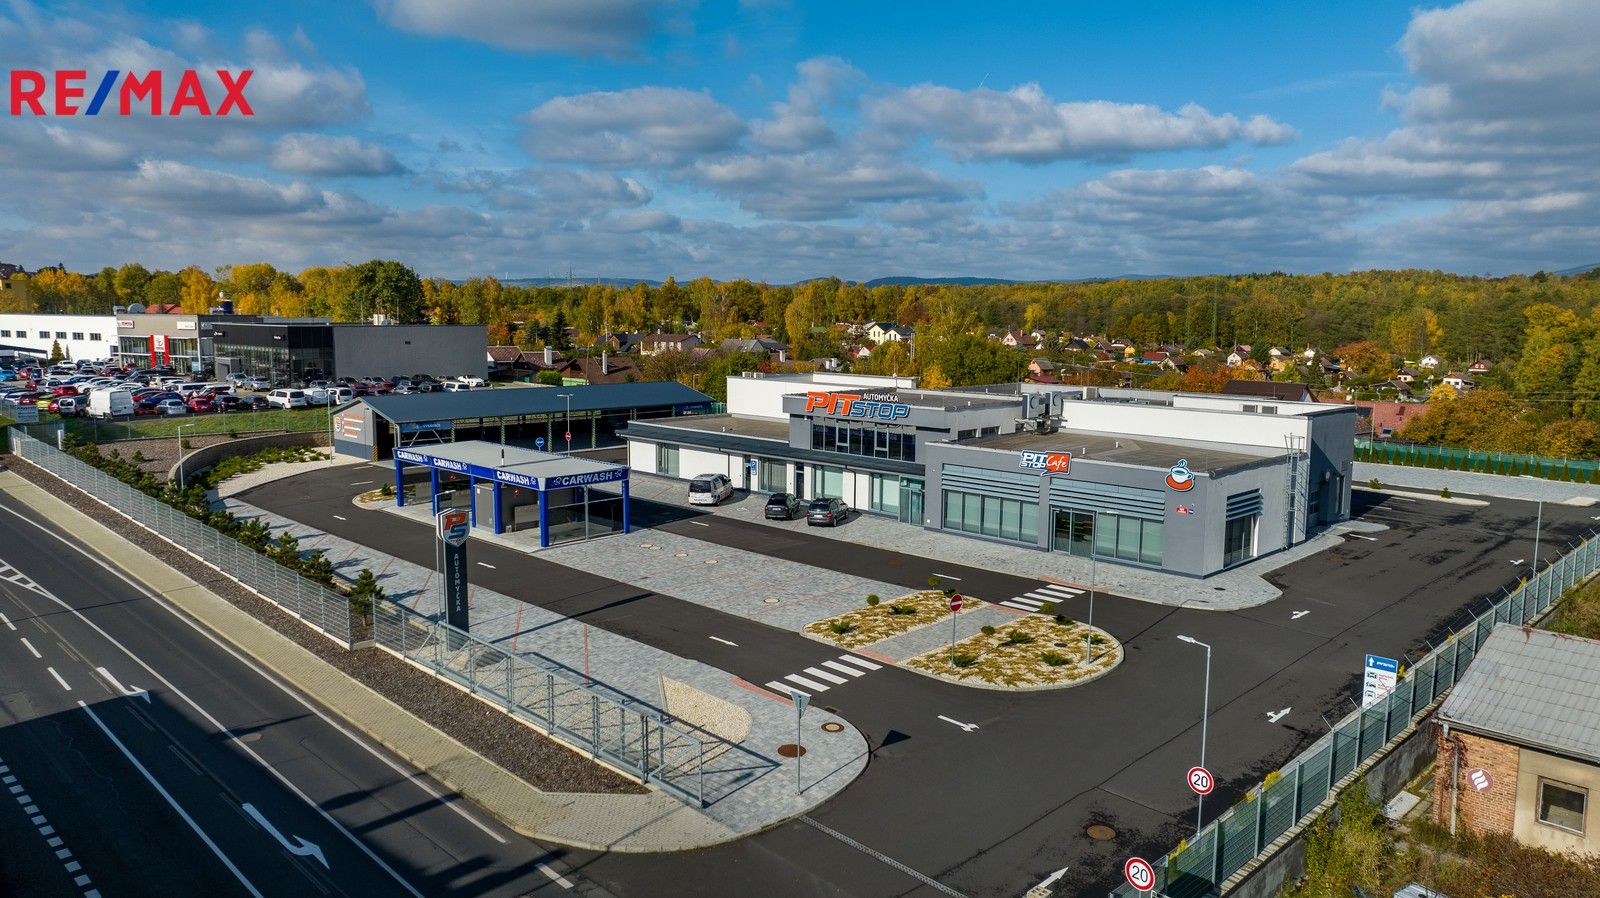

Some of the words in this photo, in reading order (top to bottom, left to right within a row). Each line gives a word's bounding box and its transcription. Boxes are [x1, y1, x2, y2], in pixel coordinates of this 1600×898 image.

[805, 391, 861, 416] PIT
[863, 393, 899, 402] AUTOMYČKA
[850, 401, 910, 420] STOP
[397, 450, 423, 463] CARWASH
[433, 458, 461, 470] CARWASH
[1022, 453, 1048, 463] PIT
[496, 470, 530, 485] CARWASH
[561, 471, 613, 486] CARWASH
[1193, 773, 1208, 788] 20
[1131, 865, 1148, 882] 20
